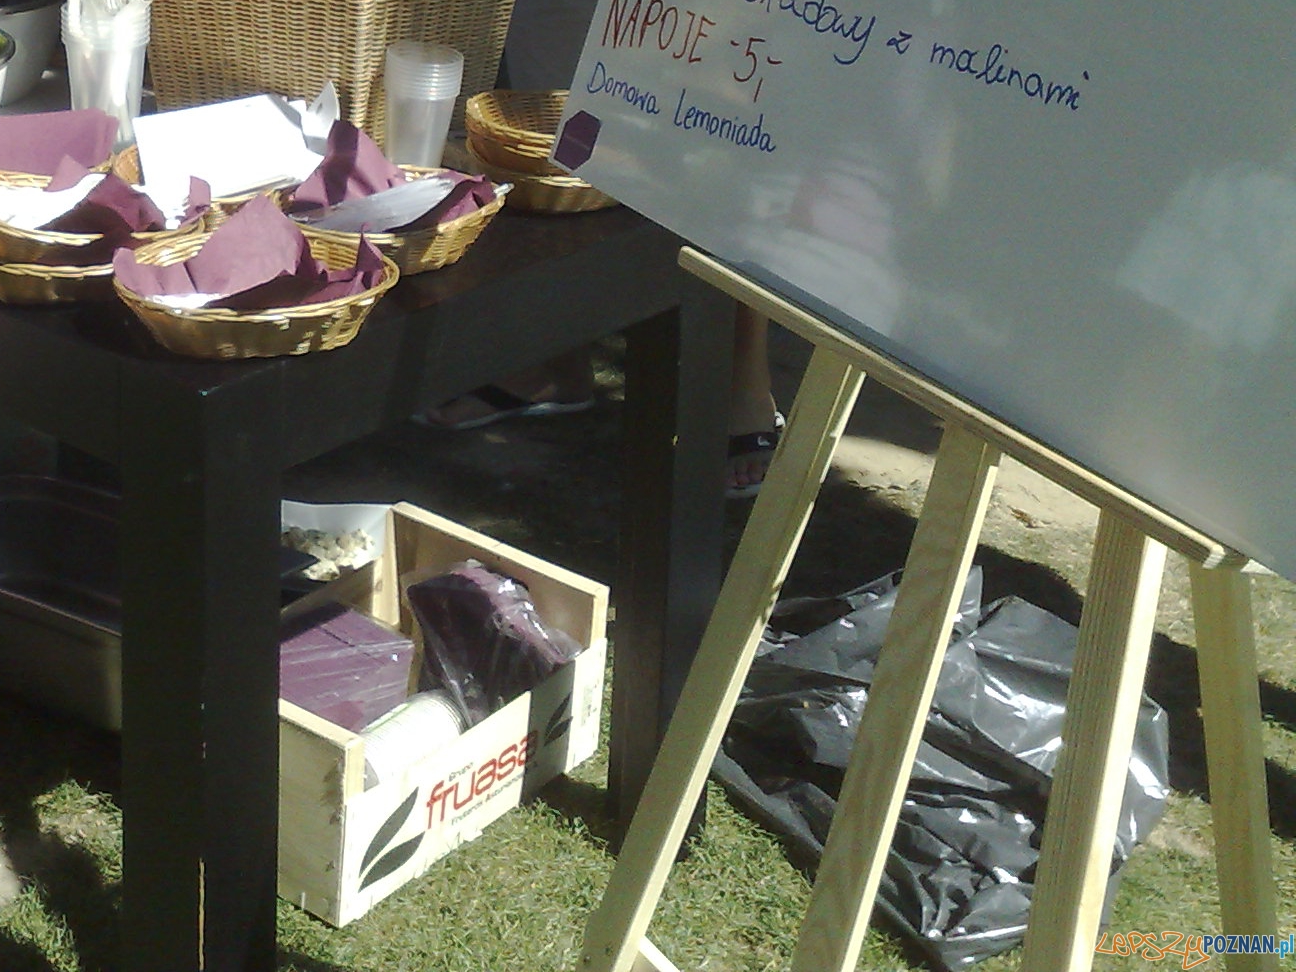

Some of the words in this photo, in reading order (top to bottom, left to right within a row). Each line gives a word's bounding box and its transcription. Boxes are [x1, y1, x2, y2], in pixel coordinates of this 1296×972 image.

[586, 61, 660, 115] Domowa
[886, 30, 913, 54] z
[930, 44, 1090, 111] malinami
